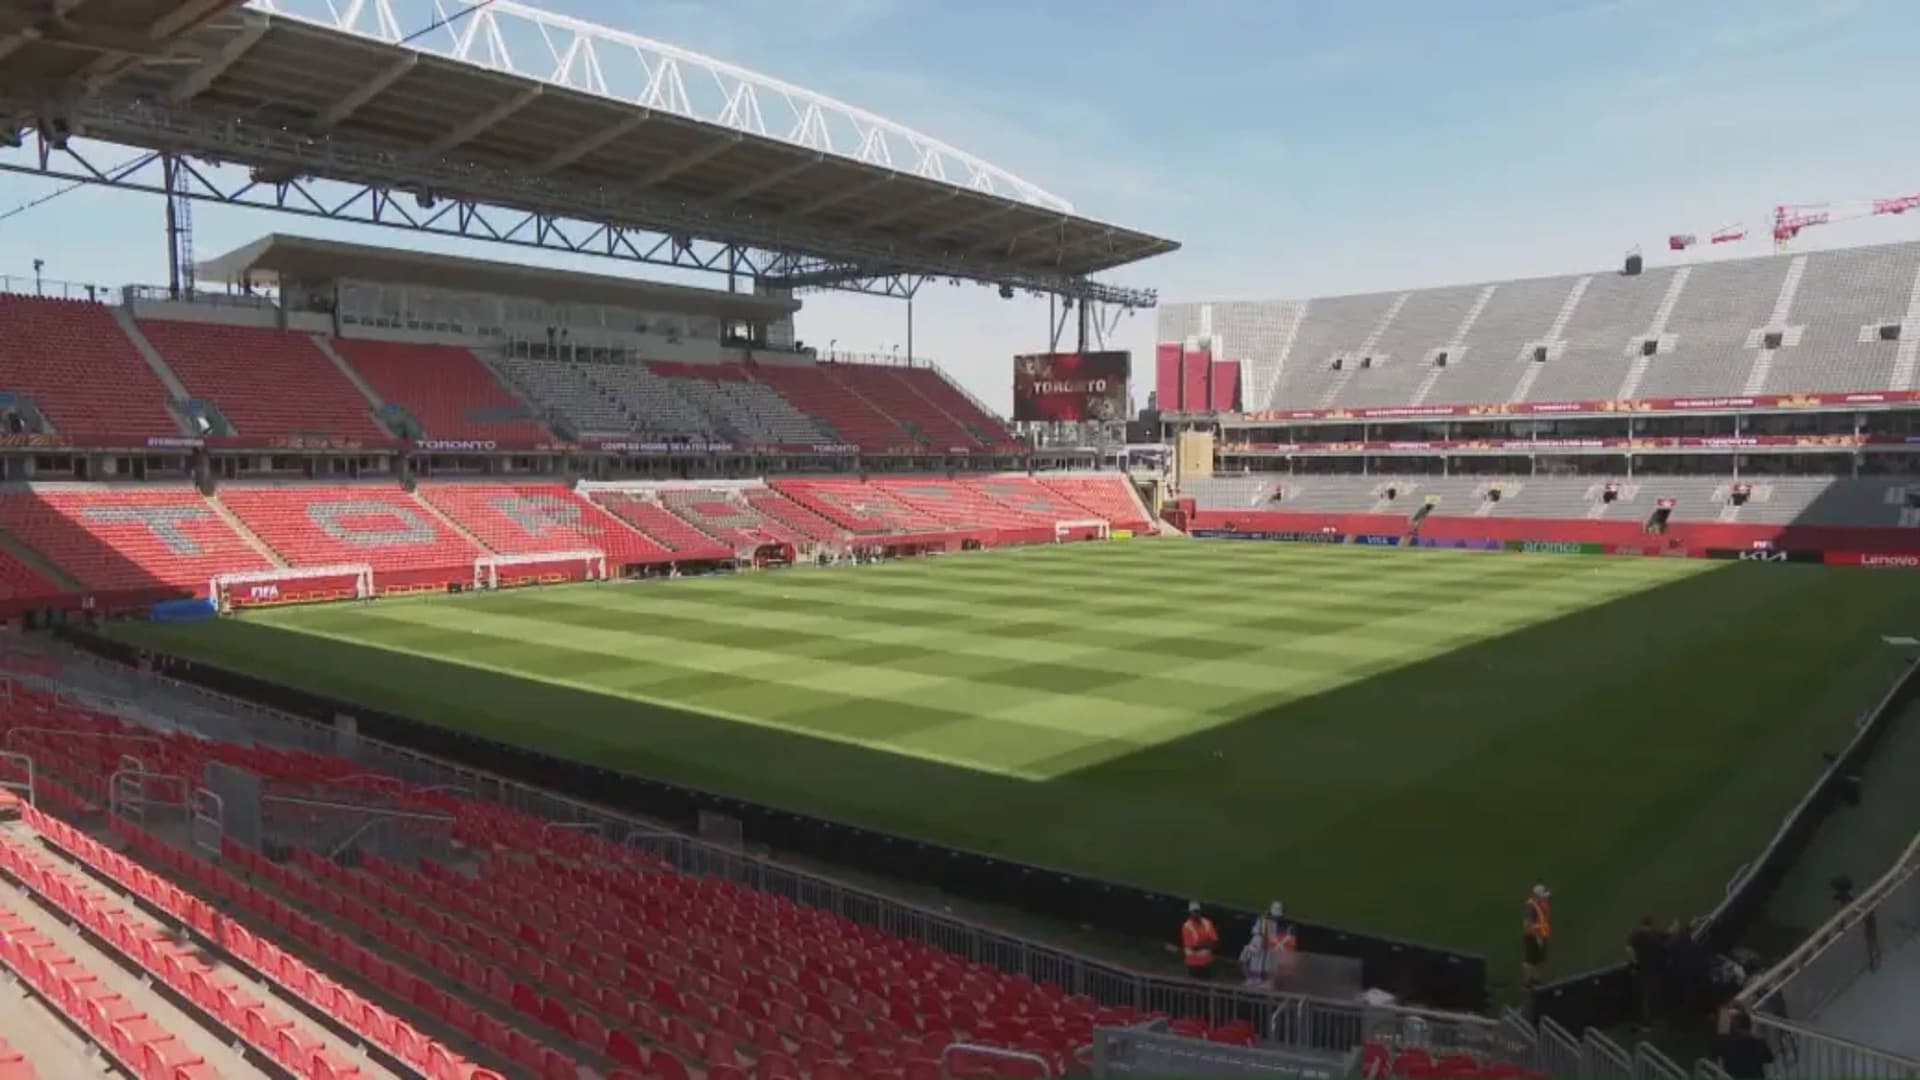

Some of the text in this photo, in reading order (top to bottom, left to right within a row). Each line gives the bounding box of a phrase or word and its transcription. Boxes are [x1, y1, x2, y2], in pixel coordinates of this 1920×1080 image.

[1033, 378, 1107, 394] TOROTO
[415, 440, 496, 449] TORONTO
[1521, 542, 1581, 554] aramco
[1739, 551, 1788, 561] KIA
[1861, 555, 1919, 567] Lenovo
[251, 586, 279, 598] FIFA
